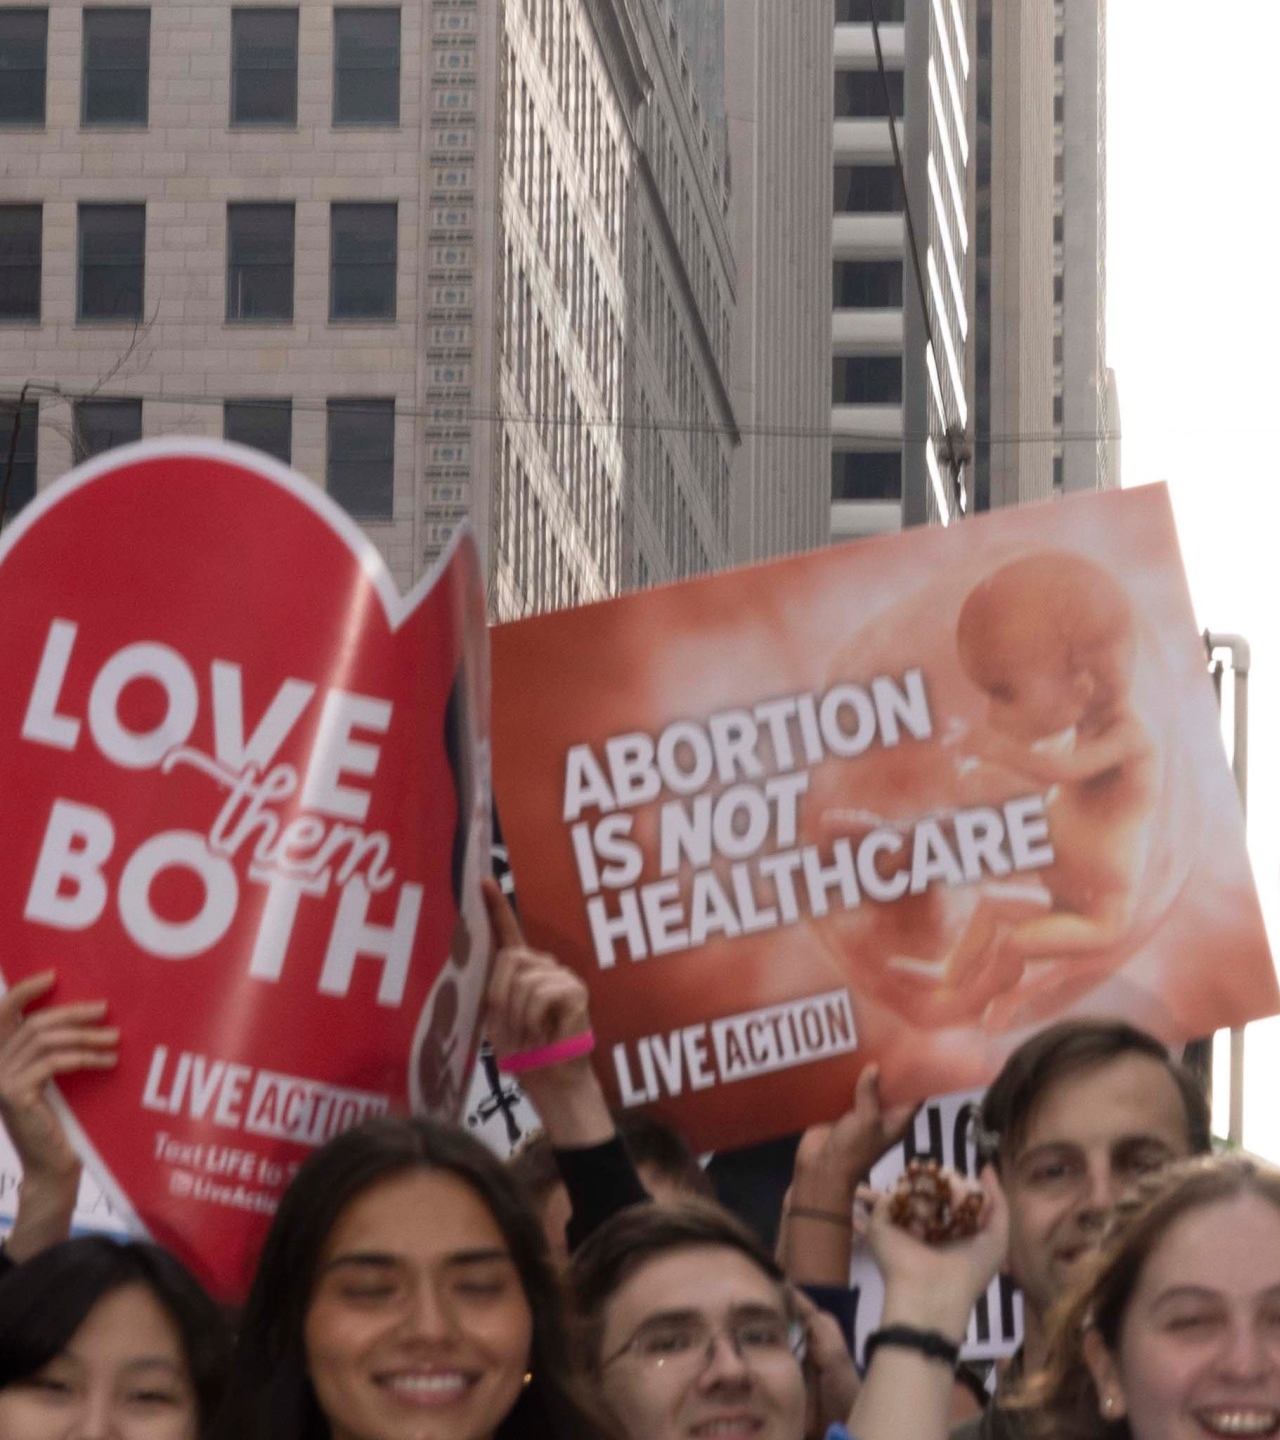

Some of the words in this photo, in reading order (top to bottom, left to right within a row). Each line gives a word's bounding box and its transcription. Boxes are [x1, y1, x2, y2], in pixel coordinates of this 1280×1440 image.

[21, 617, 394, 823] LOVE
[563, 666, 933, 822] ABORTION
[160, 745, 396, 891] them
[571, 812, 643, 894] IS
[660, 772, 809, 879] NOT
[585, 793, 1056, 970] HEALTHCARE
[23, 796, 424, 1009] BOTH
[140, 1044, 253, 1131] LIVE
[613, 1026, 716, 1108] LIVE
[720, 994, 855, 1078] ACTION
[206, 1144, 256, 1181] LIFE
